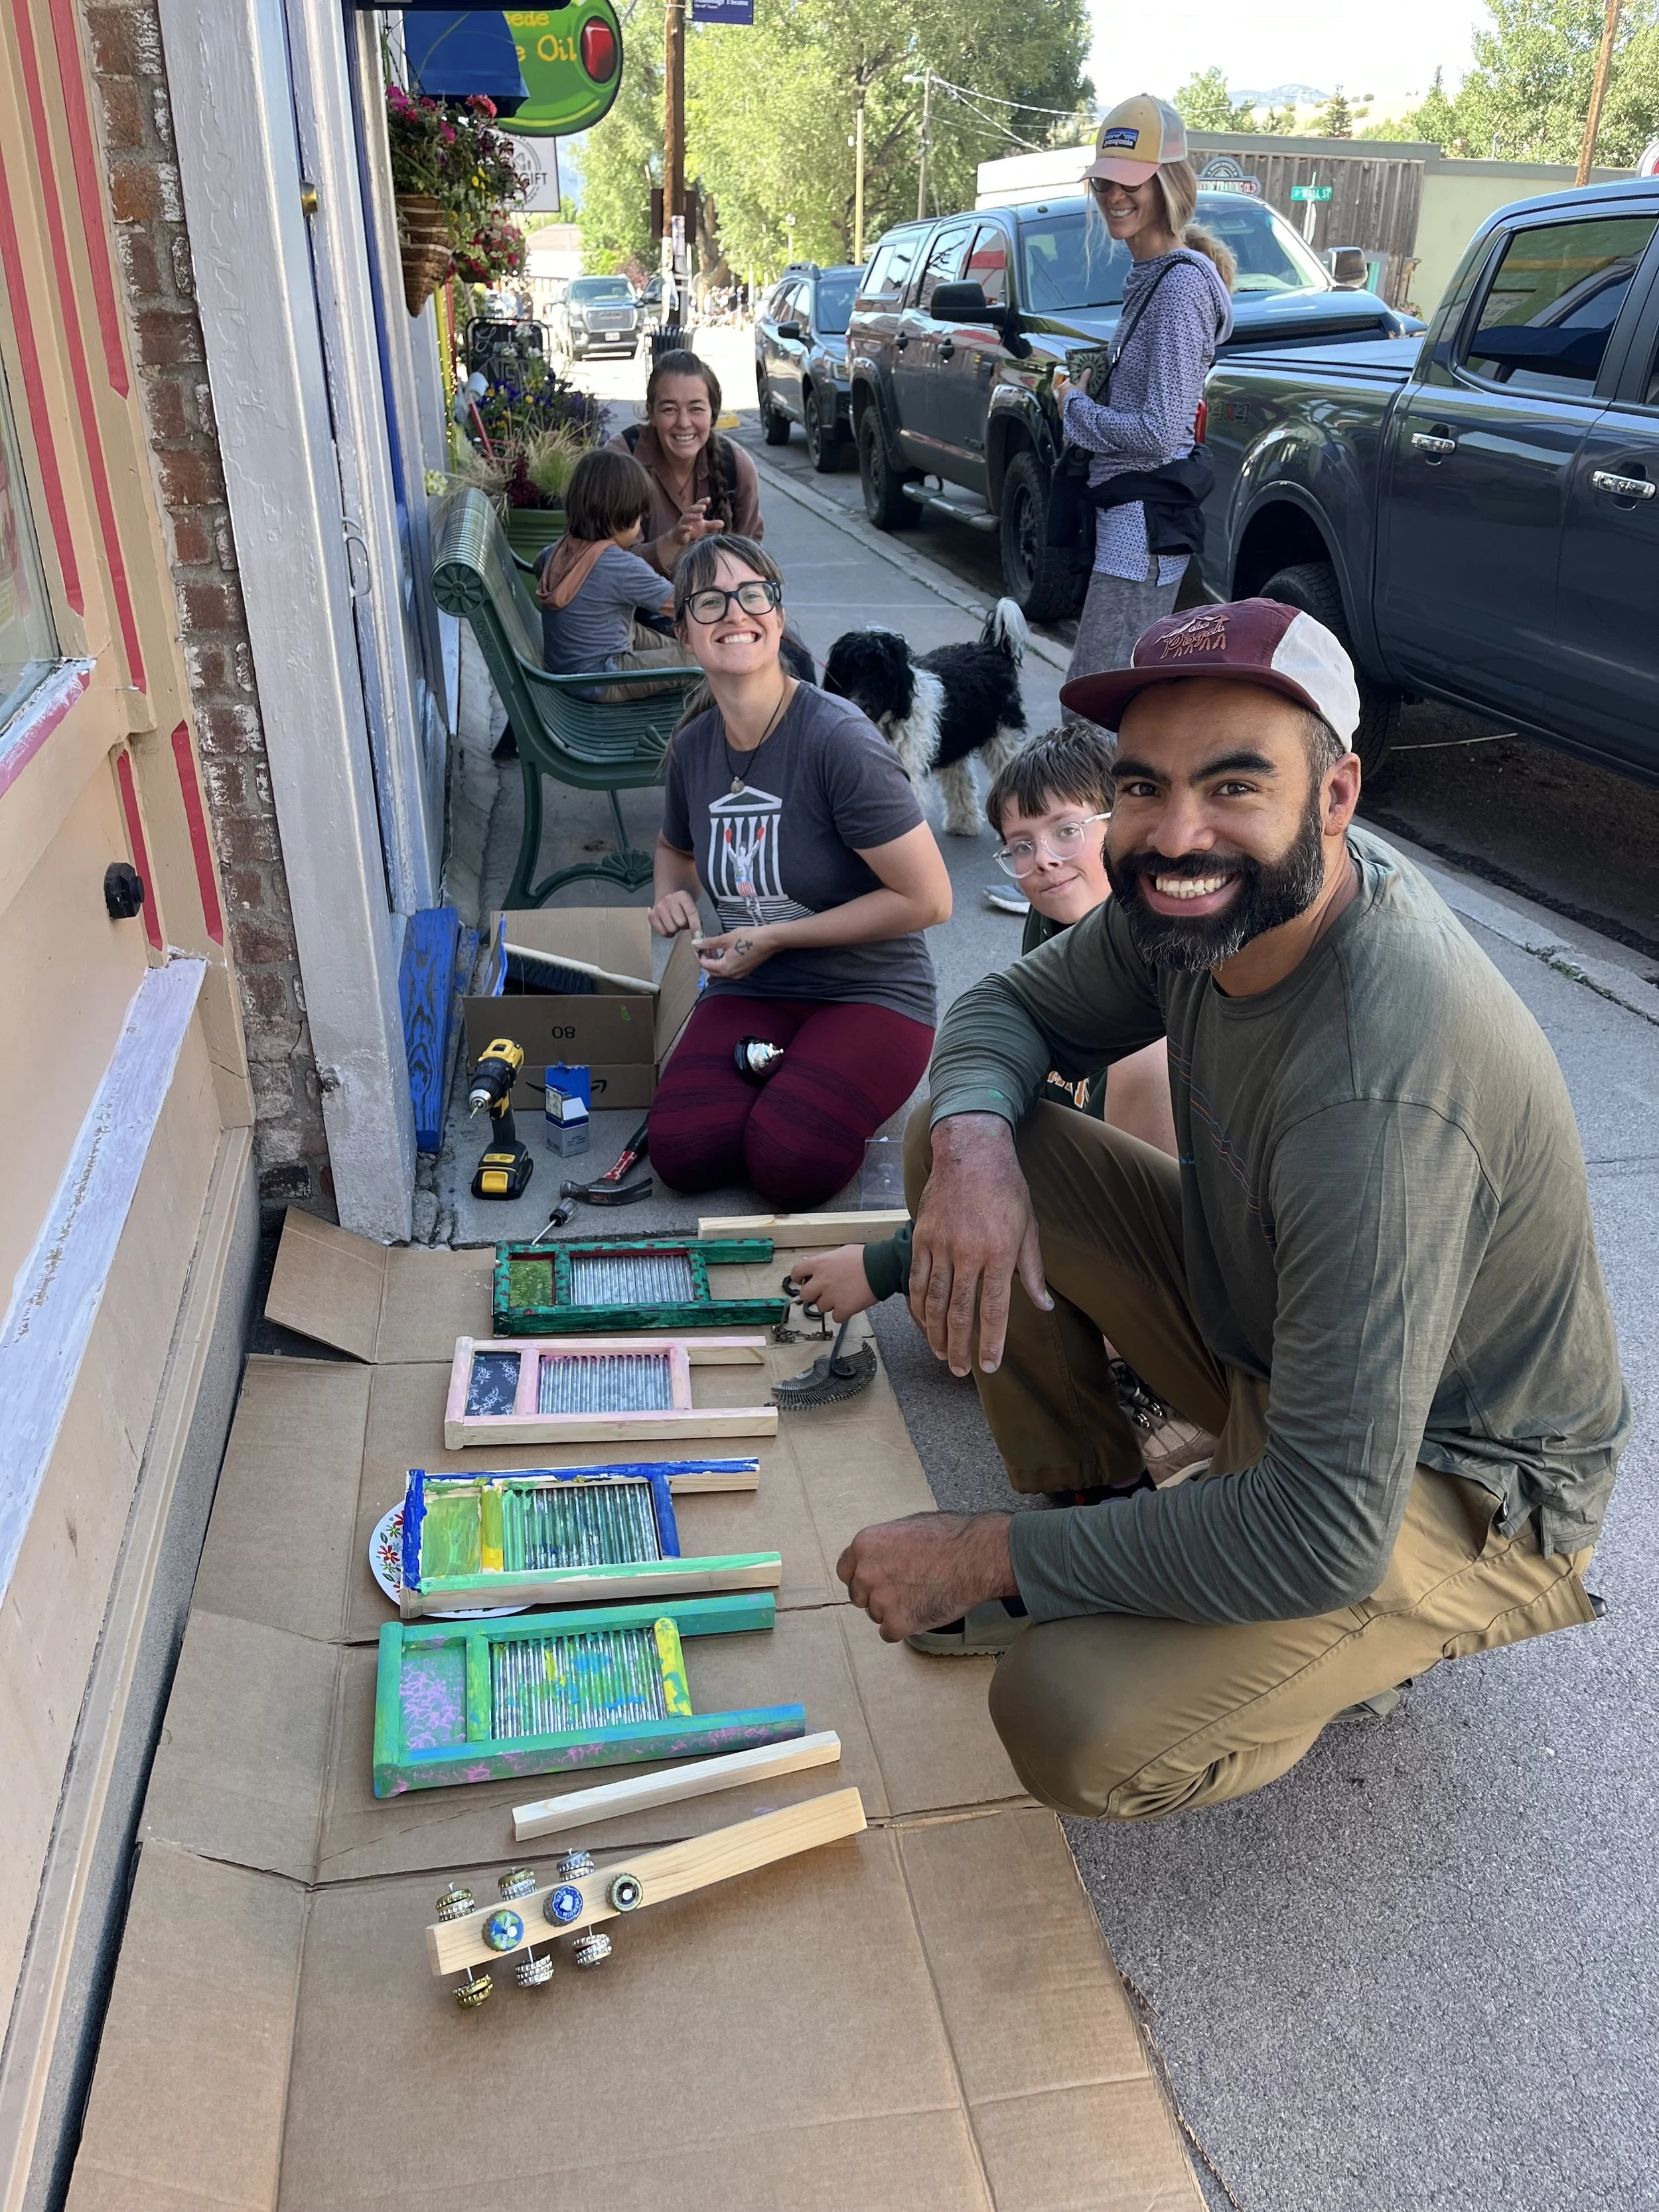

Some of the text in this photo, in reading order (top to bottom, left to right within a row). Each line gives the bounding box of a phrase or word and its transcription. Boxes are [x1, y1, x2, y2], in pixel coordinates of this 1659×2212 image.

[537, 34, 577, 62] Oil
[1302, 188, 1331, 199] WALL ST
[556, 1889, 566, 1903] BEER
[563, 1897, 580, 1917] PREMIUM
